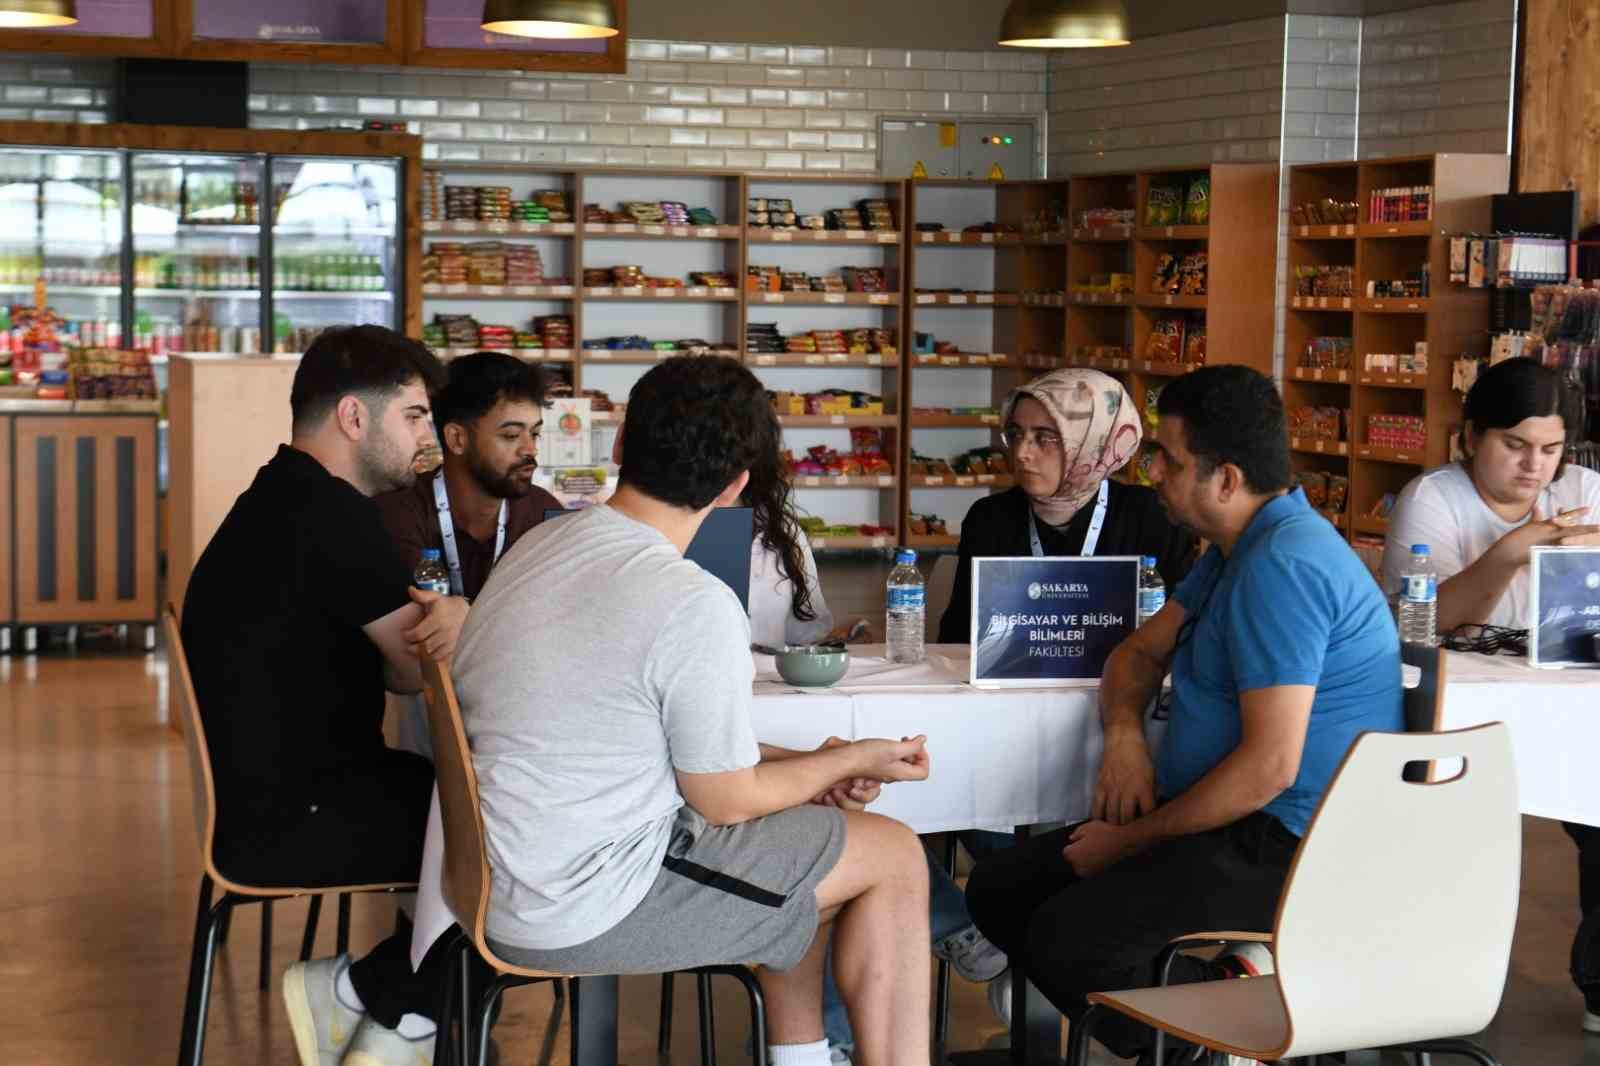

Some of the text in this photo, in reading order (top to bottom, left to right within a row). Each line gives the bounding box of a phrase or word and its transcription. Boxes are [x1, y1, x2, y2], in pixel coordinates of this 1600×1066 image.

[1041, 583, 1089, 593] SAKARYA
[992, 612, 1123, 628] BİLGİSAYAR VE BİLİŞİM
[1029, 628, 1086, 641] BİLİMLERİ
